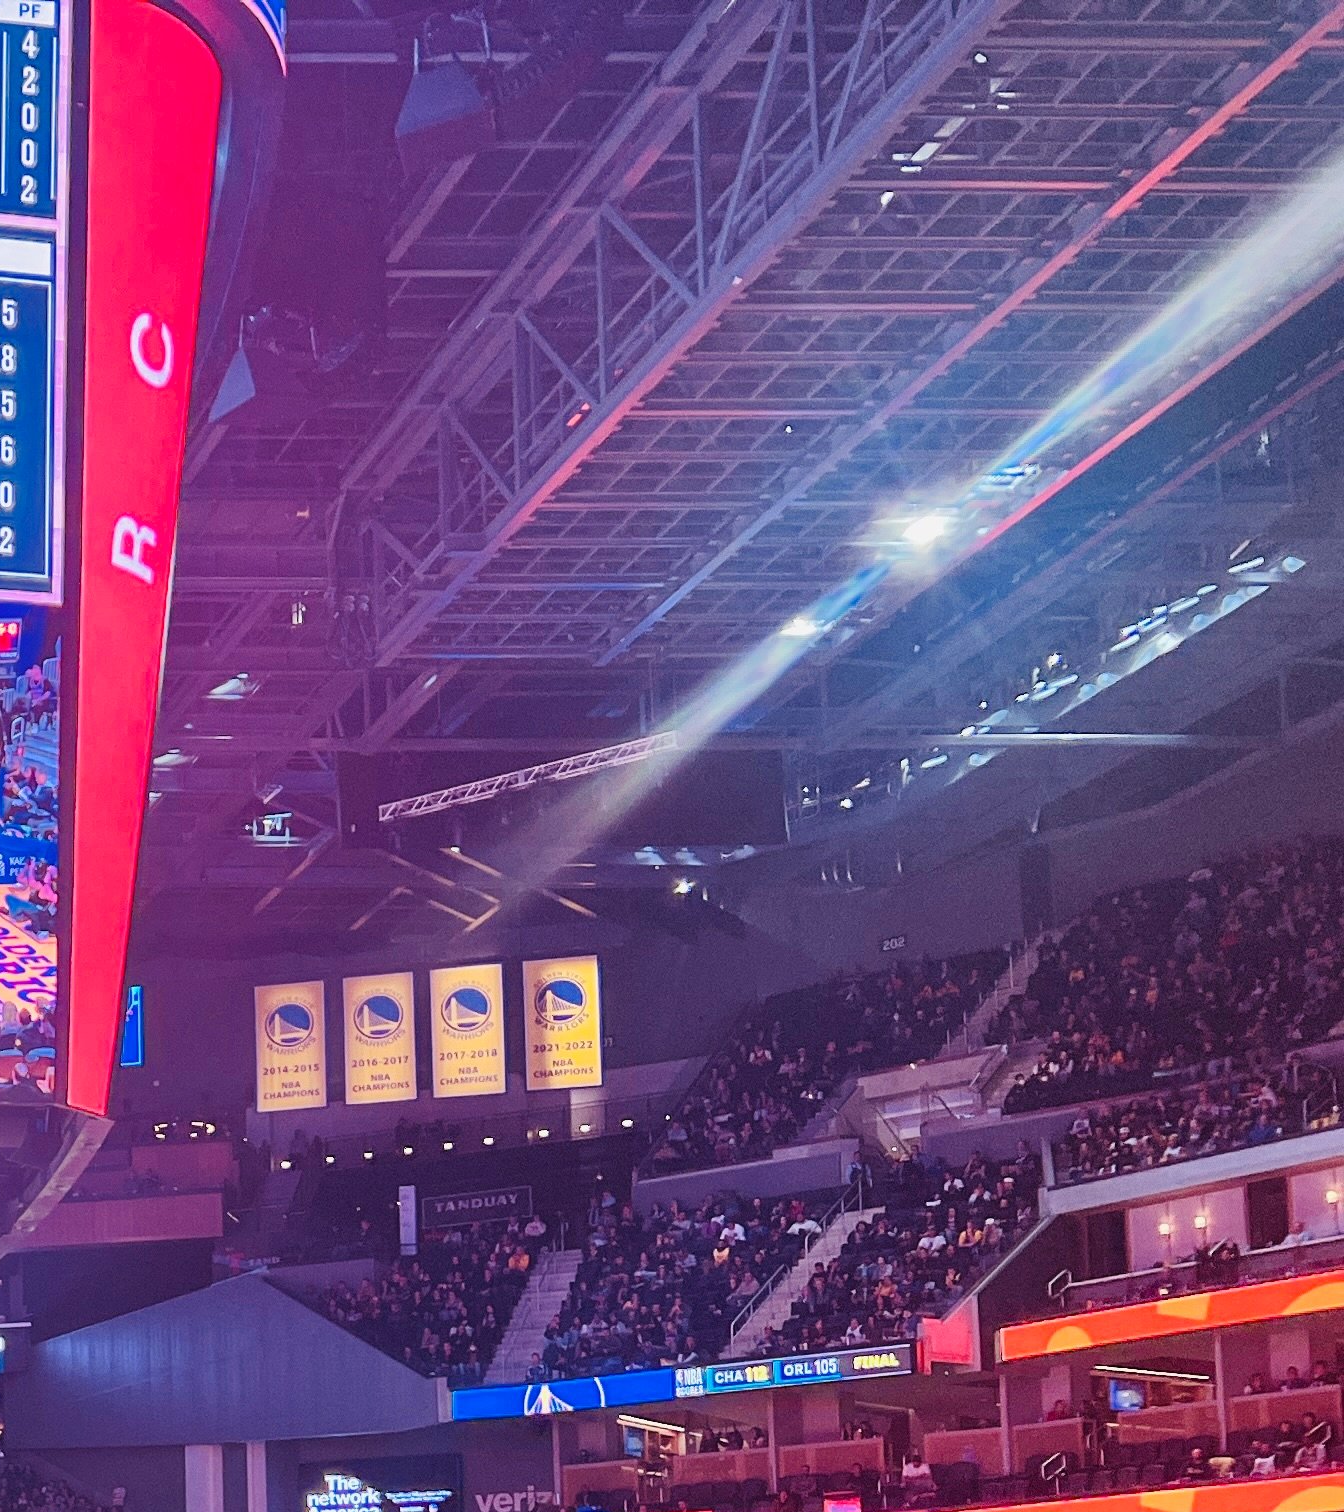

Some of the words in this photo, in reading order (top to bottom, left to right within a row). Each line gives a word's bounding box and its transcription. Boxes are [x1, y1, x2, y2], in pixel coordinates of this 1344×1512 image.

[19, 3, 41, 18] PF
[533, 1040, 593, 1053] 2021-2022
[553, 1059, 573, 1067] NBA
[533, 1067, 594, 1078] CHAMPIONS
[440, 1075, 498, 1085] CHAMPIONS
[353, 1082, 410, 1092] CHAMPIONS
[264, 1089, 320, 1100] CHAMPIONS
[434, 1194, 518, 1213] TANDUAY
[783, 1362, 812, 1377] ORL
[814, 1358, 837, 1375] 105
[715, 1370, 743, 1383] CHA
[324, 1474, 360, 1491] The
[306, 1489, 381, 1506] network
